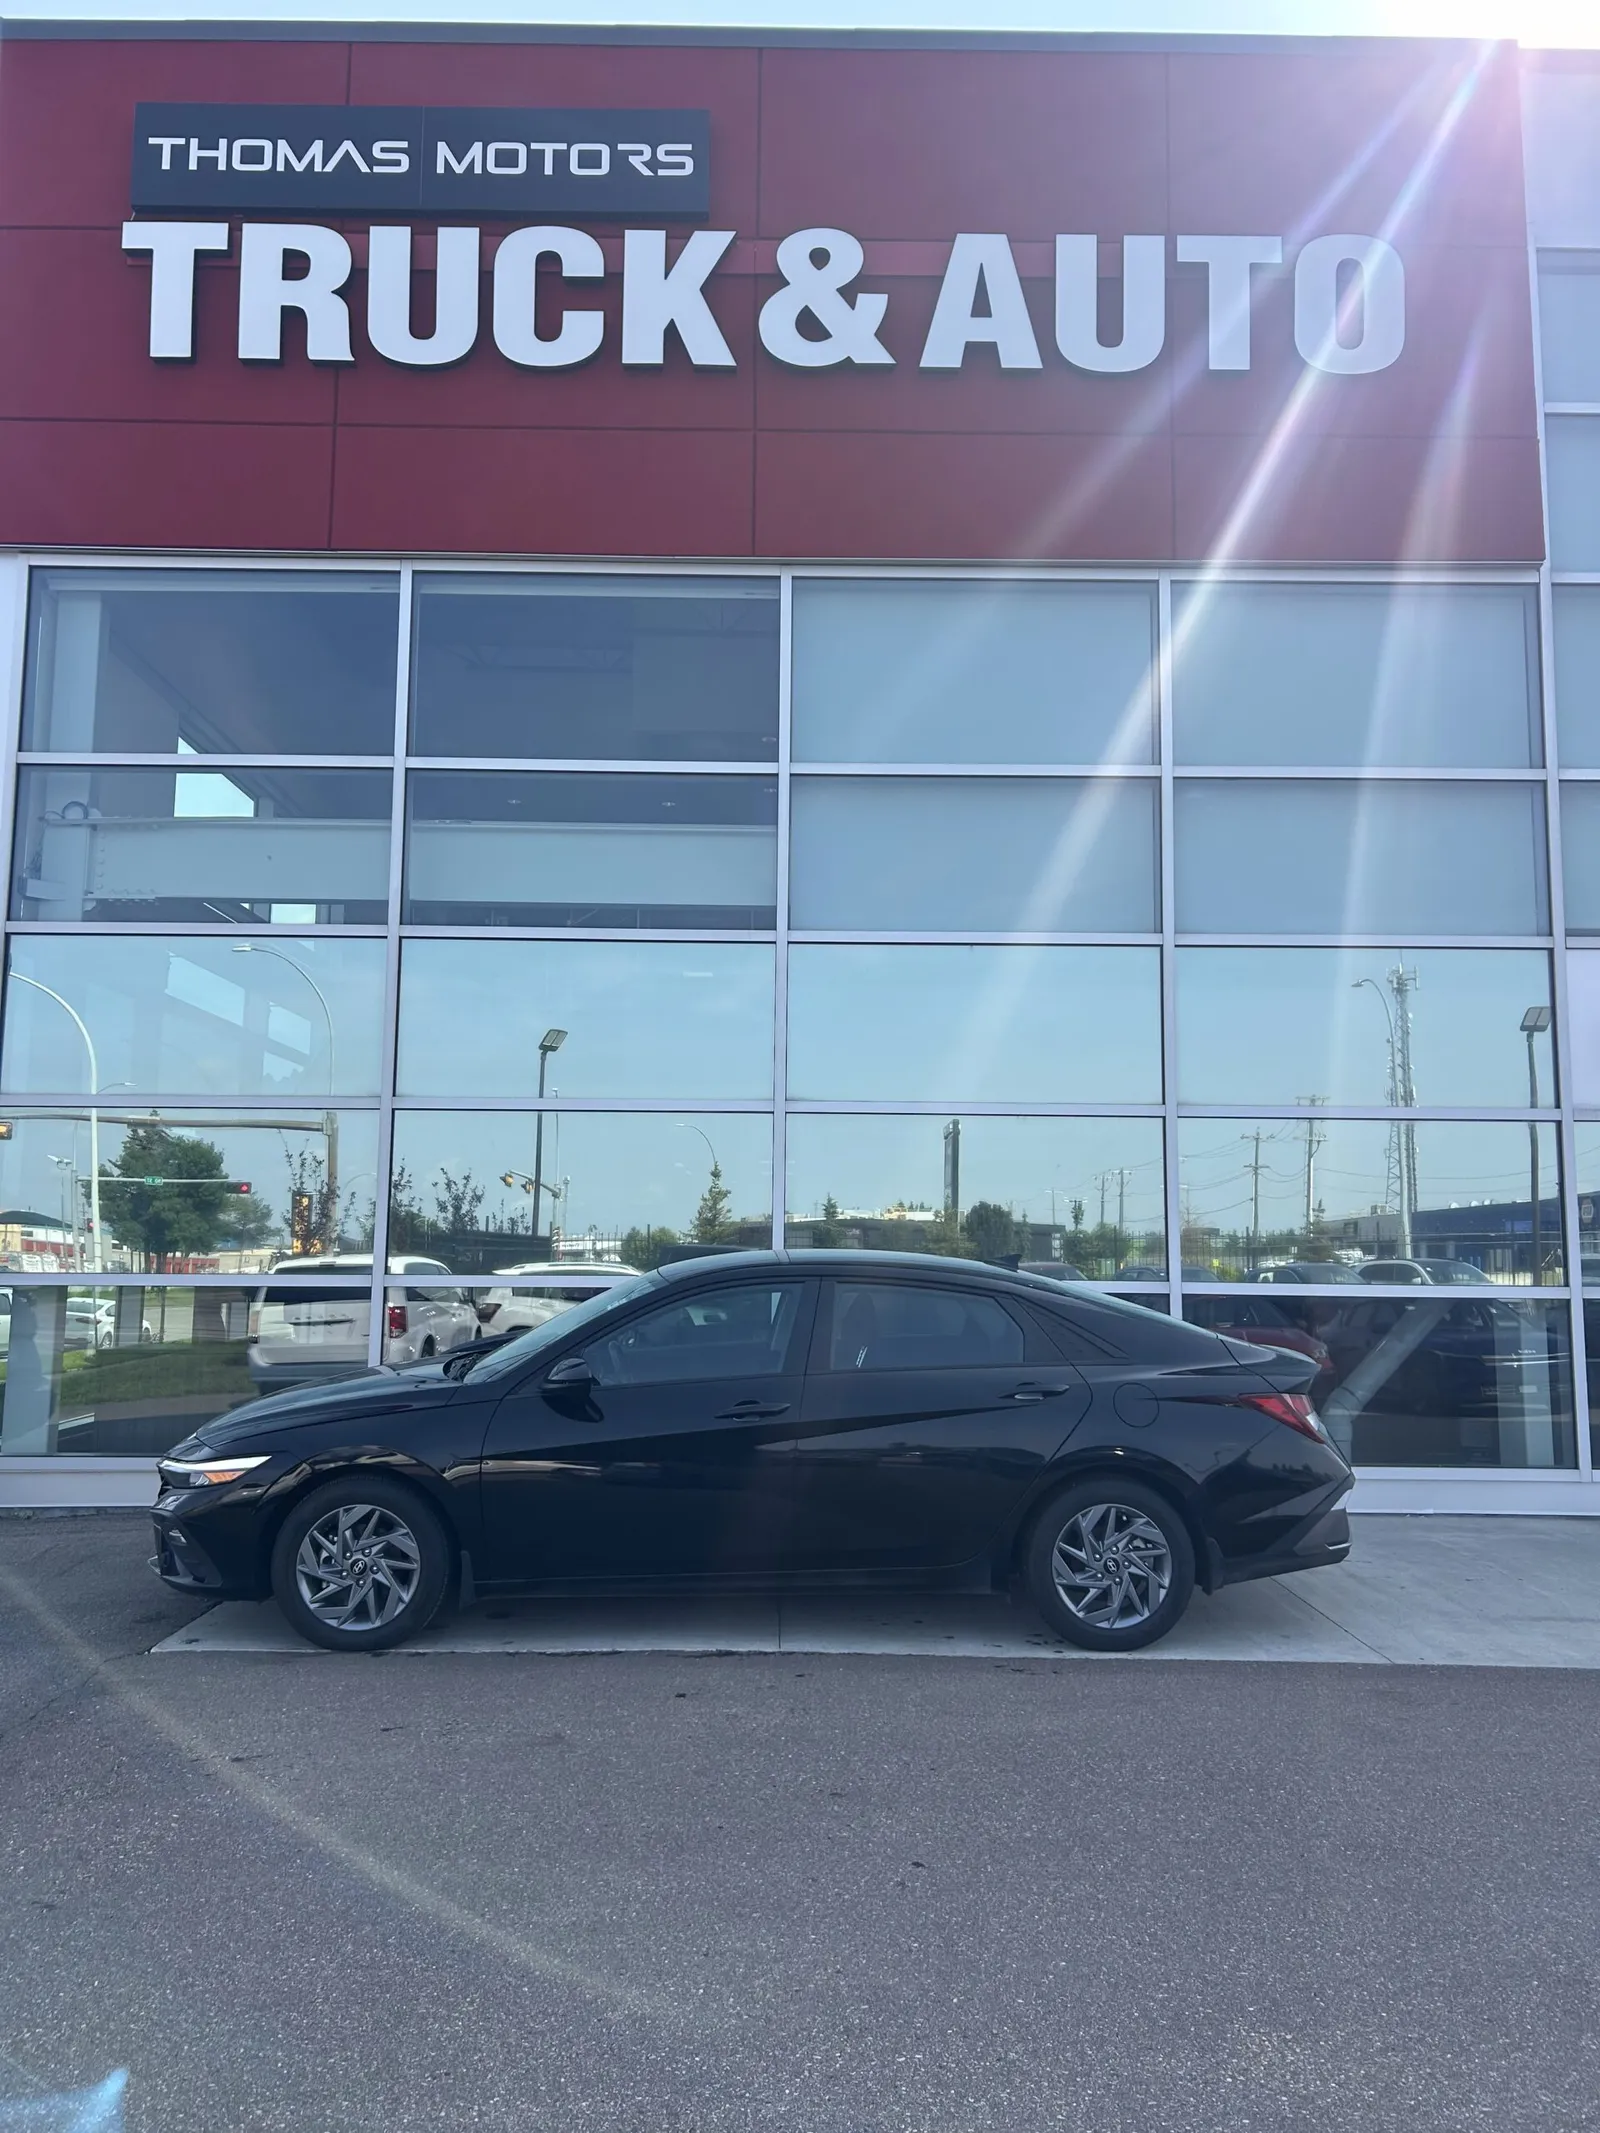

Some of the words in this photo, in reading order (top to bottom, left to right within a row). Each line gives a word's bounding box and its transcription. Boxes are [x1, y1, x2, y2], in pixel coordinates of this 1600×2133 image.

[148, 137, 409, 173] THOMAS
[436, 141, 694, 176] MOTORS
[121, 221, 738, 367] TRUCK
[759, 227, 896, 368] &
[919, 232, 1406, 375] AUTO
